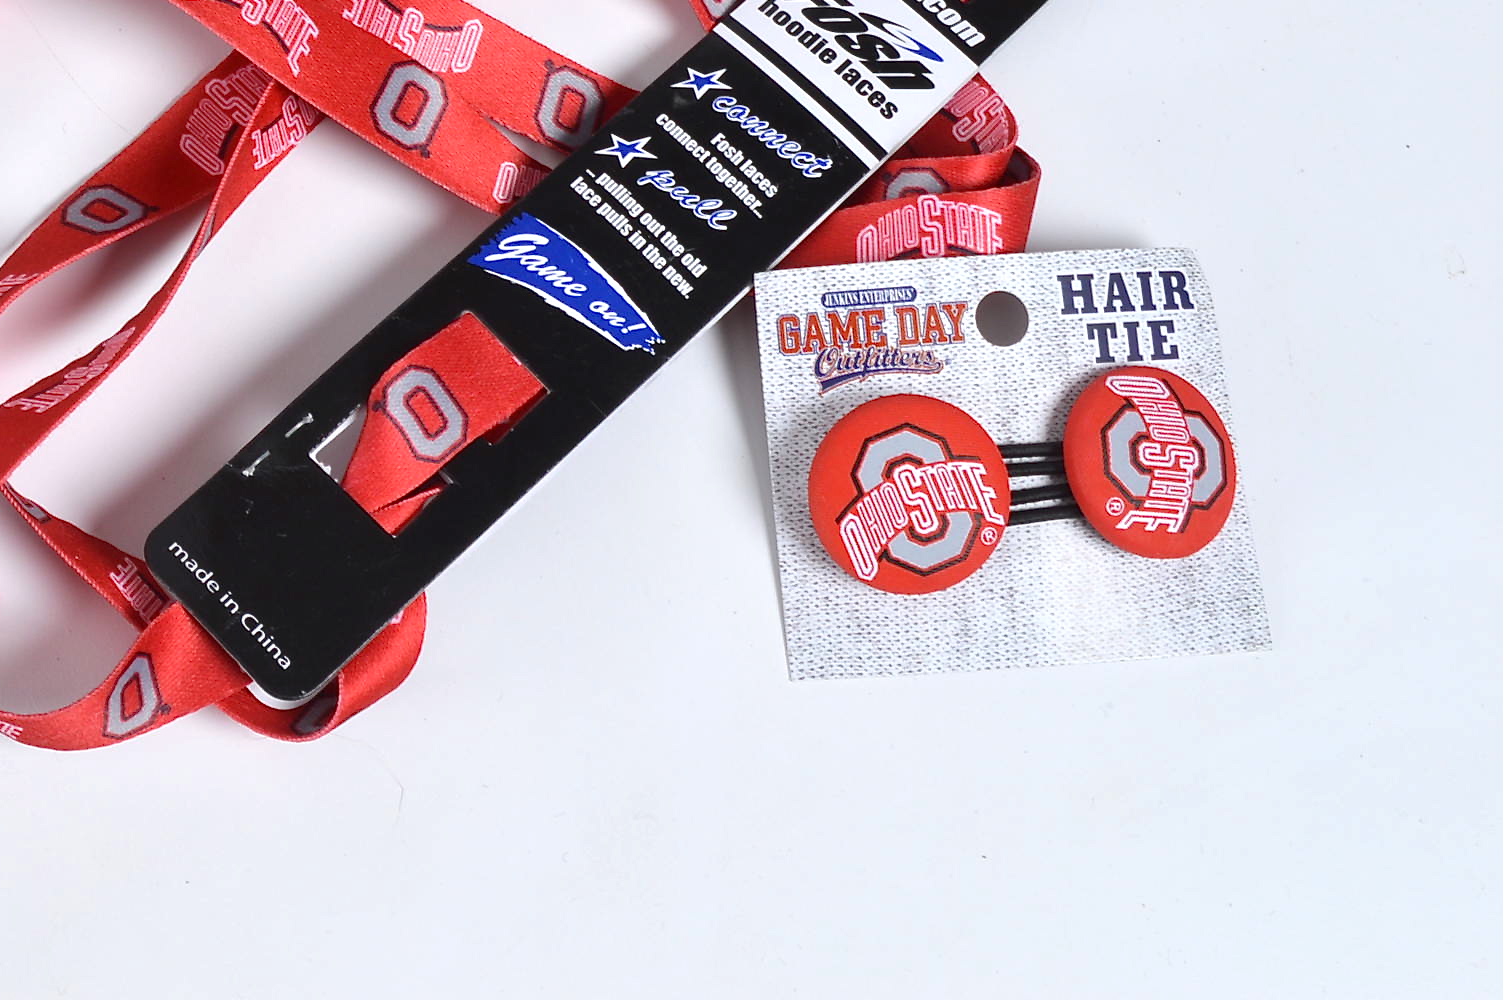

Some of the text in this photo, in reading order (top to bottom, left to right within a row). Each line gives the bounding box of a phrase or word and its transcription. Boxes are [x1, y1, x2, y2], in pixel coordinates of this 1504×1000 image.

[833, 59, 899, 120] laces
[655, 113, 711, 163] connect
[710, 132, 779, 198] Fosh laces
[711, 95, 834, 179] connect
[637, 169, 737, 231] pull
[570, 176, 603, 207] lace
[596, 202, 634, 237] pulls
[628, 230, 647, 251] in
[641, 243, 667, 271] the
[662, 265, 695, 300] new.
[640, 213, 666, 238] out
[660, 231, 686, 258] the
[681, 252, 708, 279] old
[484, 233, 647, 334] Game on!
[1056, 270, 1195, 316] HAIR
[776, 301, 968, 356] GAME DAY
[1087, 319, 1180, 364] TIE
[814, 346, 941, 386] Outfitters
[168, 540, 292, 671] made in China
